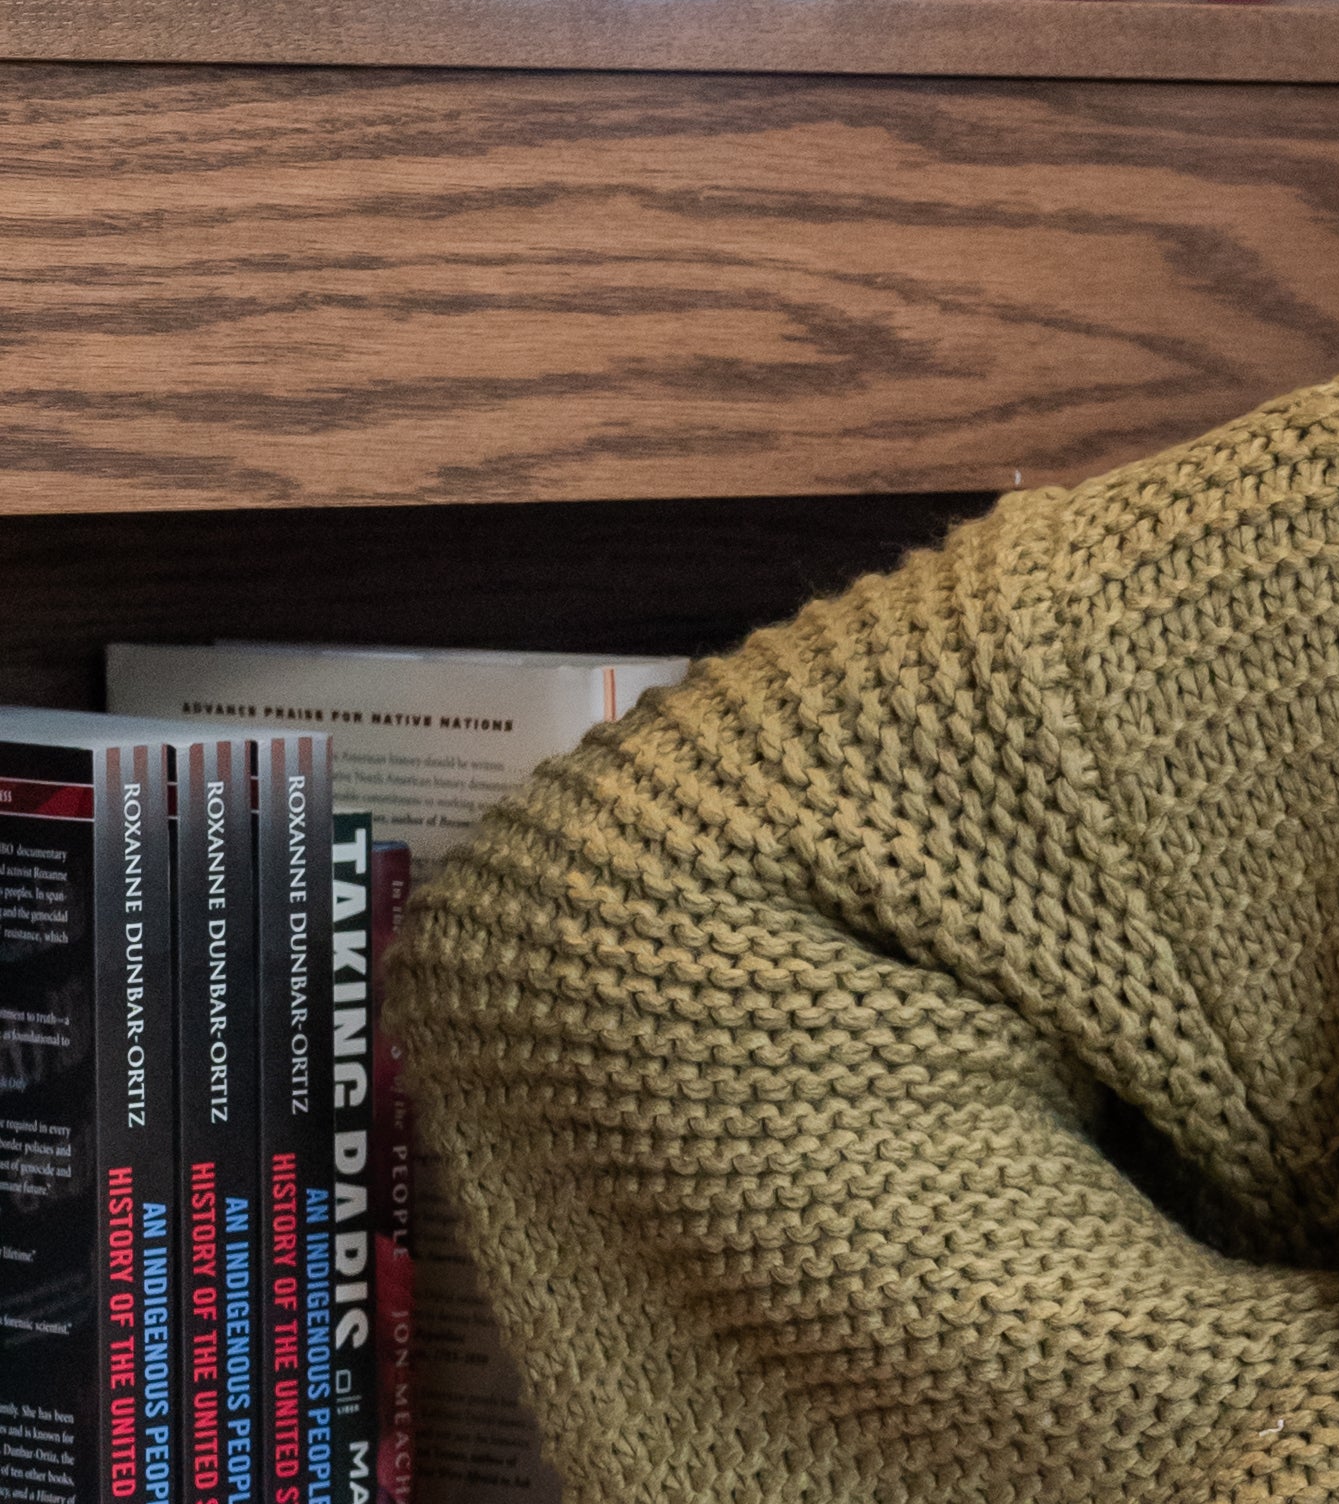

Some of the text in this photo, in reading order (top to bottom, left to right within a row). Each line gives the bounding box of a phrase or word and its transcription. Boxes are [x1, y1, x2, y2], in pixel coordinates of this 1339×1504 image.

[183, 703, 513, 732] ADVANCE PRAISE FOR NATIVE NATIONS
[124, 782, 145, 1128] ROXANNE DUNBAR-ORTIZ
[208, 781, 228, 1124] ROXANNE DUNBAR-ORTIZ
[288, 775, 308, 1115] ROXANNE DUNBAR-ORTIZ
[333, 827, 367, 1108] TAKING
[56, 1145, 72, 1157] and
[56, 1165, 72, 1178] and
[109, 1166, 133, 1284] HISTORY
[143, 1202, 166, 1239] AN
[191, 1161, 216, 1278] HISTORY
[225, 1196, 249, 1234] AN
[272, 1153, 296, 1267] HISTORY
[306, 1188, 329, 1224] AN
[392, 1145, 409, 1260] PEOPLE
[110, 1293, 134, 1328] OF
[192, 1287, 217, 1322] OF
[274, 1276, 297, 1311] OF
[306, 1232, 330, 1402] INDIGENOUS
[143, 1248, 169, 1418] INDIGENOUS
[225, 1241, 250, 1411] INDIGENOUS
[274, 1319, 298, 1372] THE
[392, 1310, 409, 1368] JON
[110, 1336, 135, 1389] THE
[193, 1330, 218, 1383] THE
[53, 1410, 74, 1424] been
[194, 1392, 218, 1490] UNITED
[275, 1381, 298, 1479] UNITED
[4, 1444, 60, 1464] Dunbar-Ortiz,
[111, 1399, 136, 1497] UNITED
